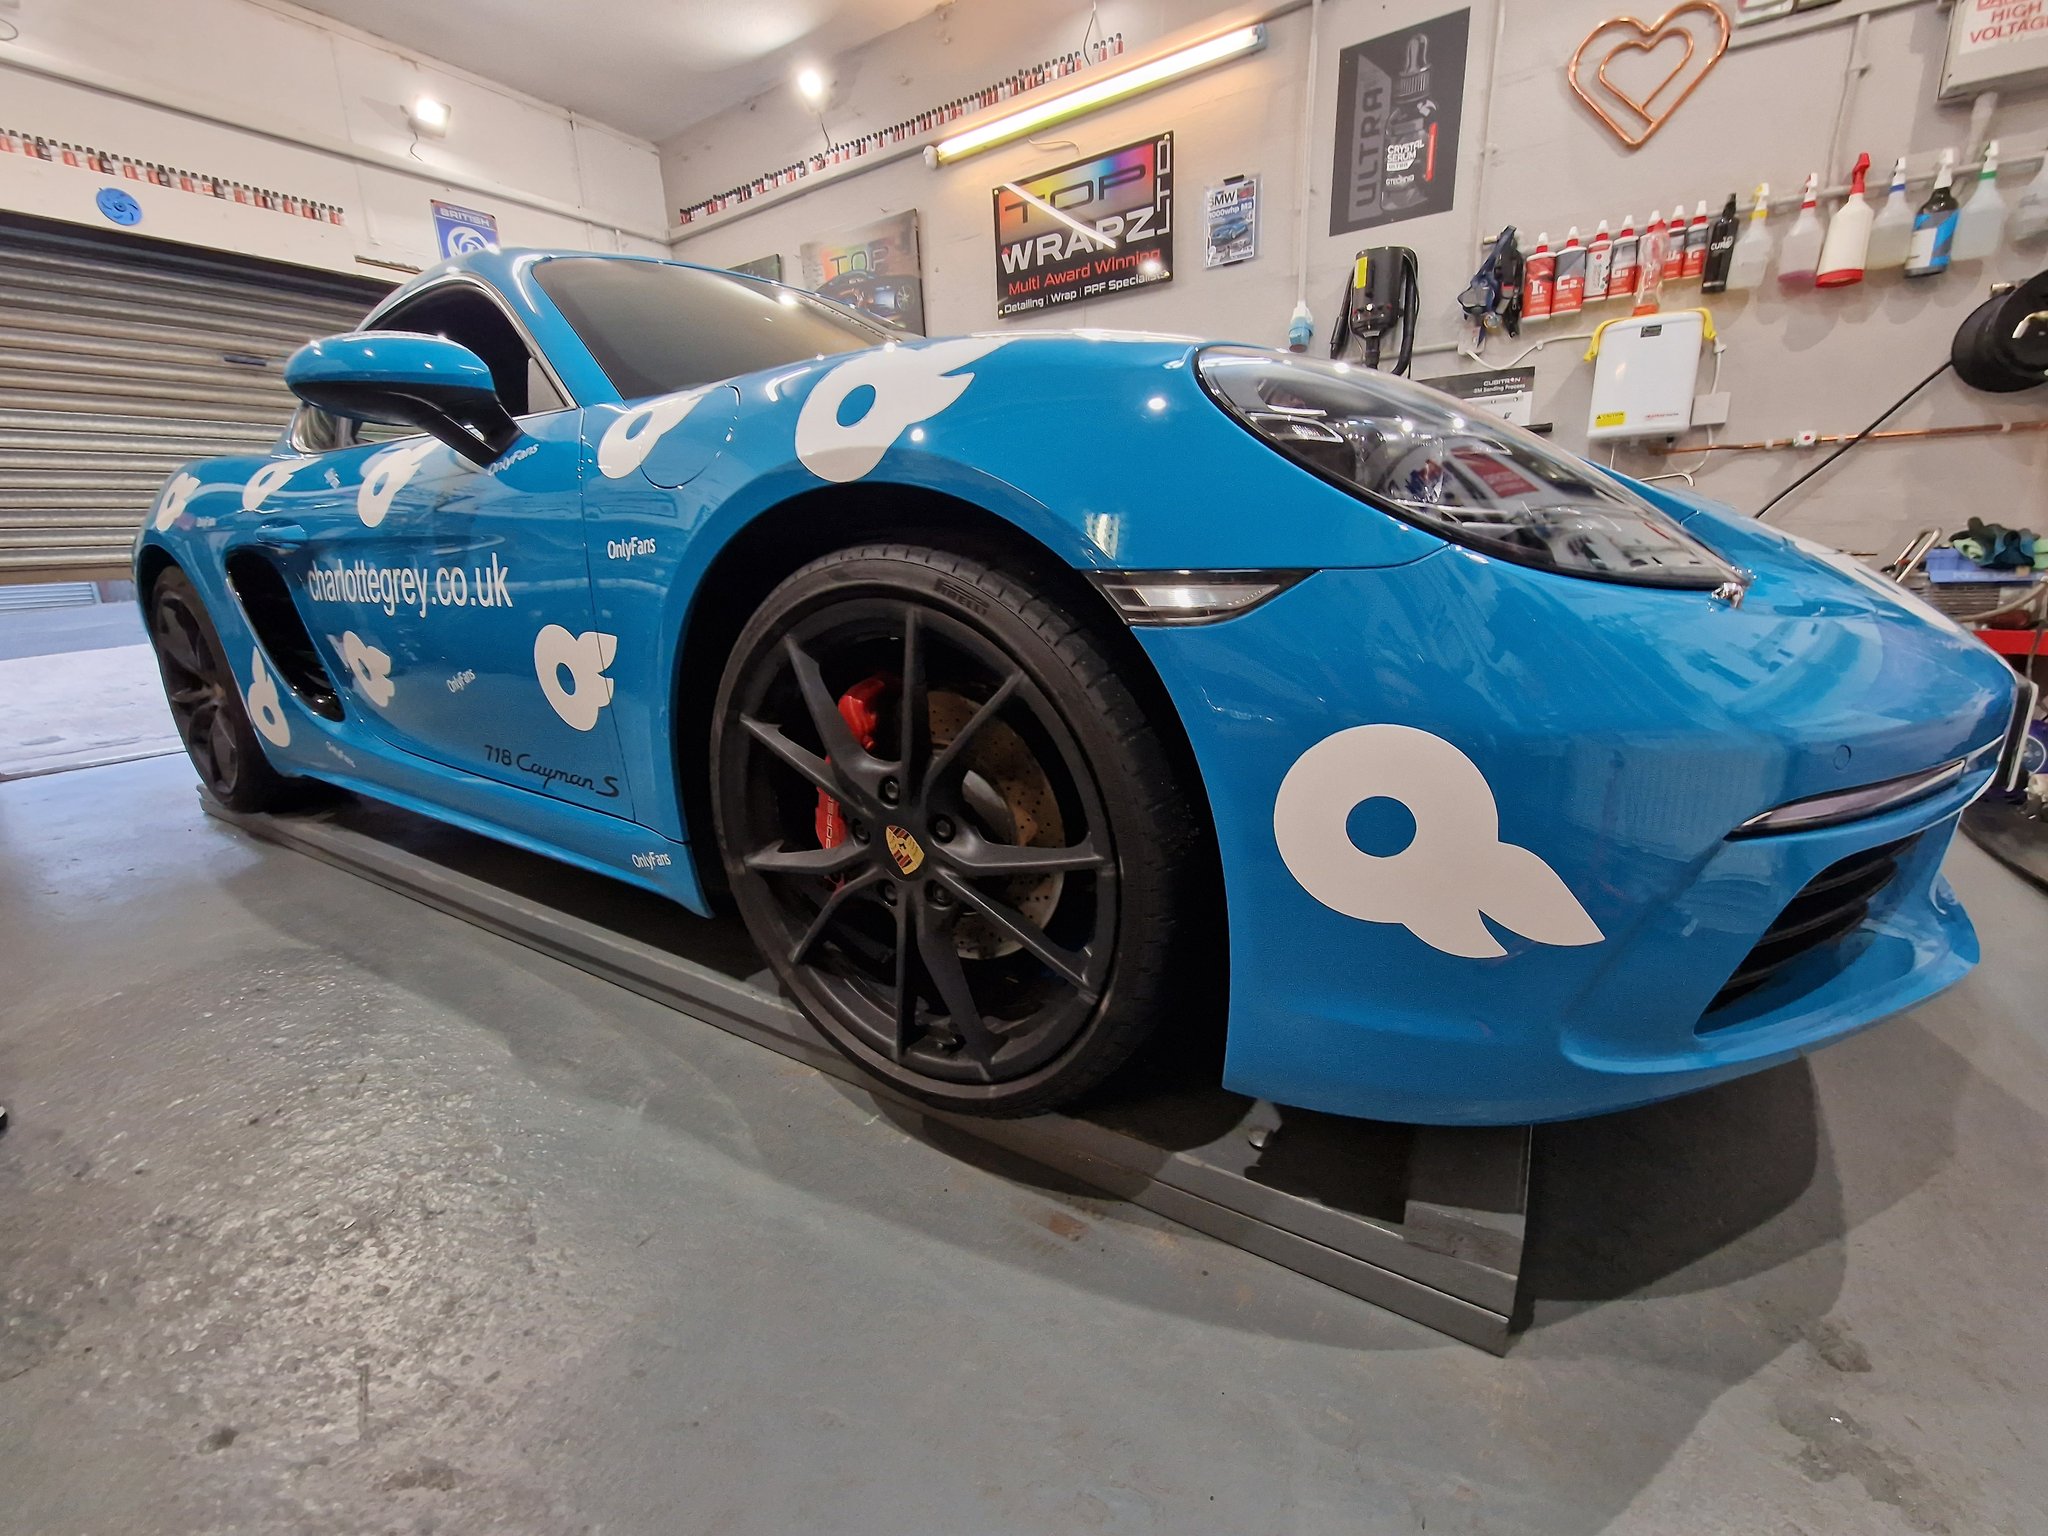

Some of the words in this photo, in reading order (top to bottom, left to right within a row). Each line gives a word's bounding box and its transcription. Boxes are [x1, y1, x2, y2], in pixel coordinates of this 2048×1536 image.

[1991, 4, 2042, 22] HIGH
[1970, 16, 2048, 44] VOLTAG
[1356, 87, 1384, 207] ULTRA
[1005, 164, 1146, 224] TOP
[440, 207, 490, 227] BRITISH
[1001, 206, 1155, 275] WRAPZ
[830, 246, 889, 276] TOP
[1008, 279, 1041, 296] Multi
[1044, 263, 1091, 288] Award
[1095, 248, 1161, 275] Winning
[1004, 295, 1044, 314] Detailing
[1050, 288, 1077, 303] Wrap
[1084, 281, 1106, 296] PPF
[607, 536, 657, 562] OnlyFans
[308, 552, 514, 619] charlottegrey.co.uk
[484, 744, 513, 767] 718
[516, 753, 596, 790] Cayman
[596, 775, 620, 798] S
[632, 851, 672, 871] OnlyFans
